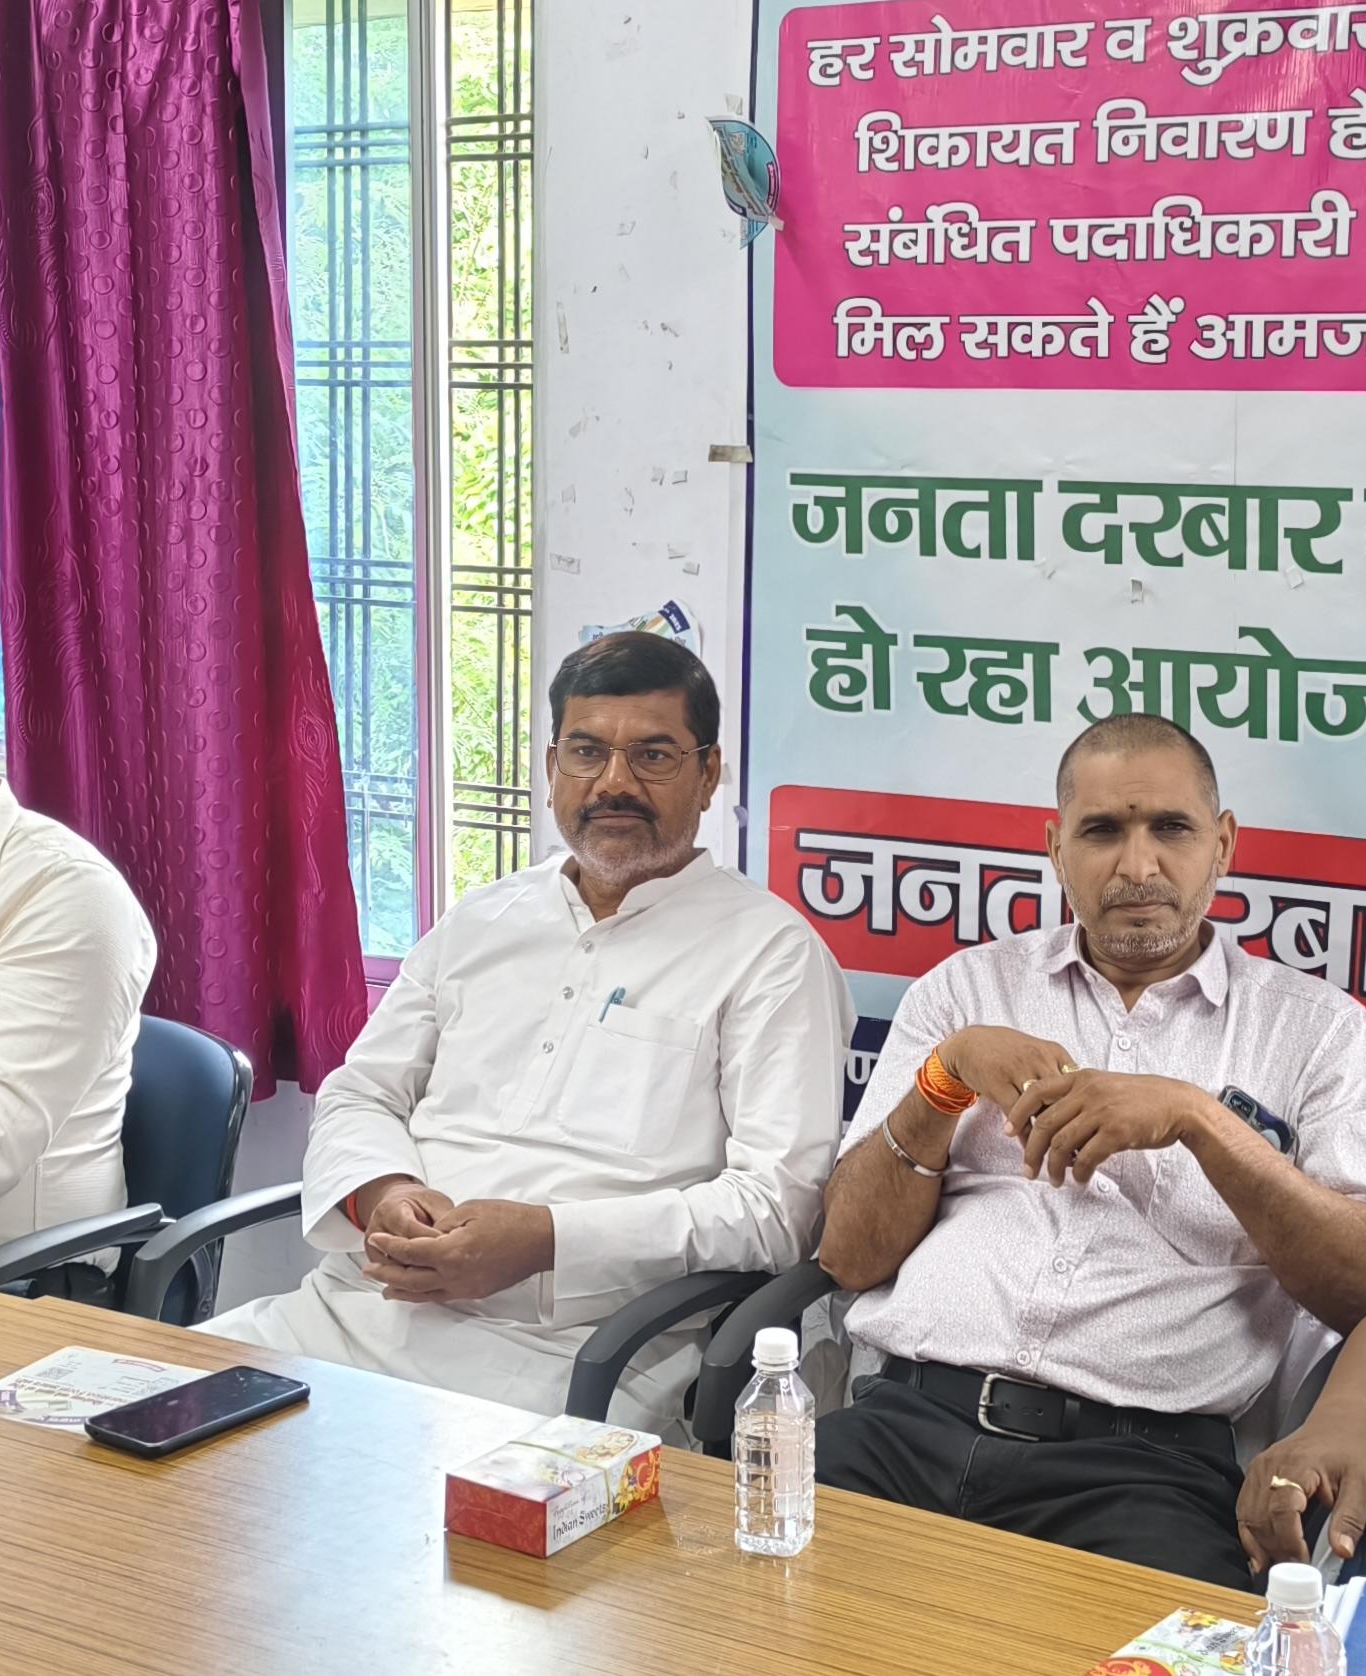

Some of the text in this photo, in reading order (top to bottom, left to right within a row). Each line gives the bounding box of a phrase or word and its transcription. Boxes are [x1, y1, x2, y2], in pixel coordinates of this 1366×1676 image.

[807, 37, 881, 86] हर
[889, 15, 1095, 78] सोमवार
[1104, 18, 1152, 63] व
[854, 111, 1080, 172] शिकायत
[1092, 99, 1313, 163] निवारण
[843, 201, 1037, 267] संबंधित
[1049, 190, 1357, 261] पदाधिकारी
[833, 297, 950, 360] मिल
[959, 298, 1115, 359] सकते
[1128, 295, 1185, 364] हैं
[790, 473, 1042, 561] जनता
[1058, 480, 1353, 575] दरबार
[805, 605, 898, 711] हो
[912, 634, 1059, 724] रहा
[795, 832, 1075, 944] जनत
[553, 1519, 578, 1541] Indian
